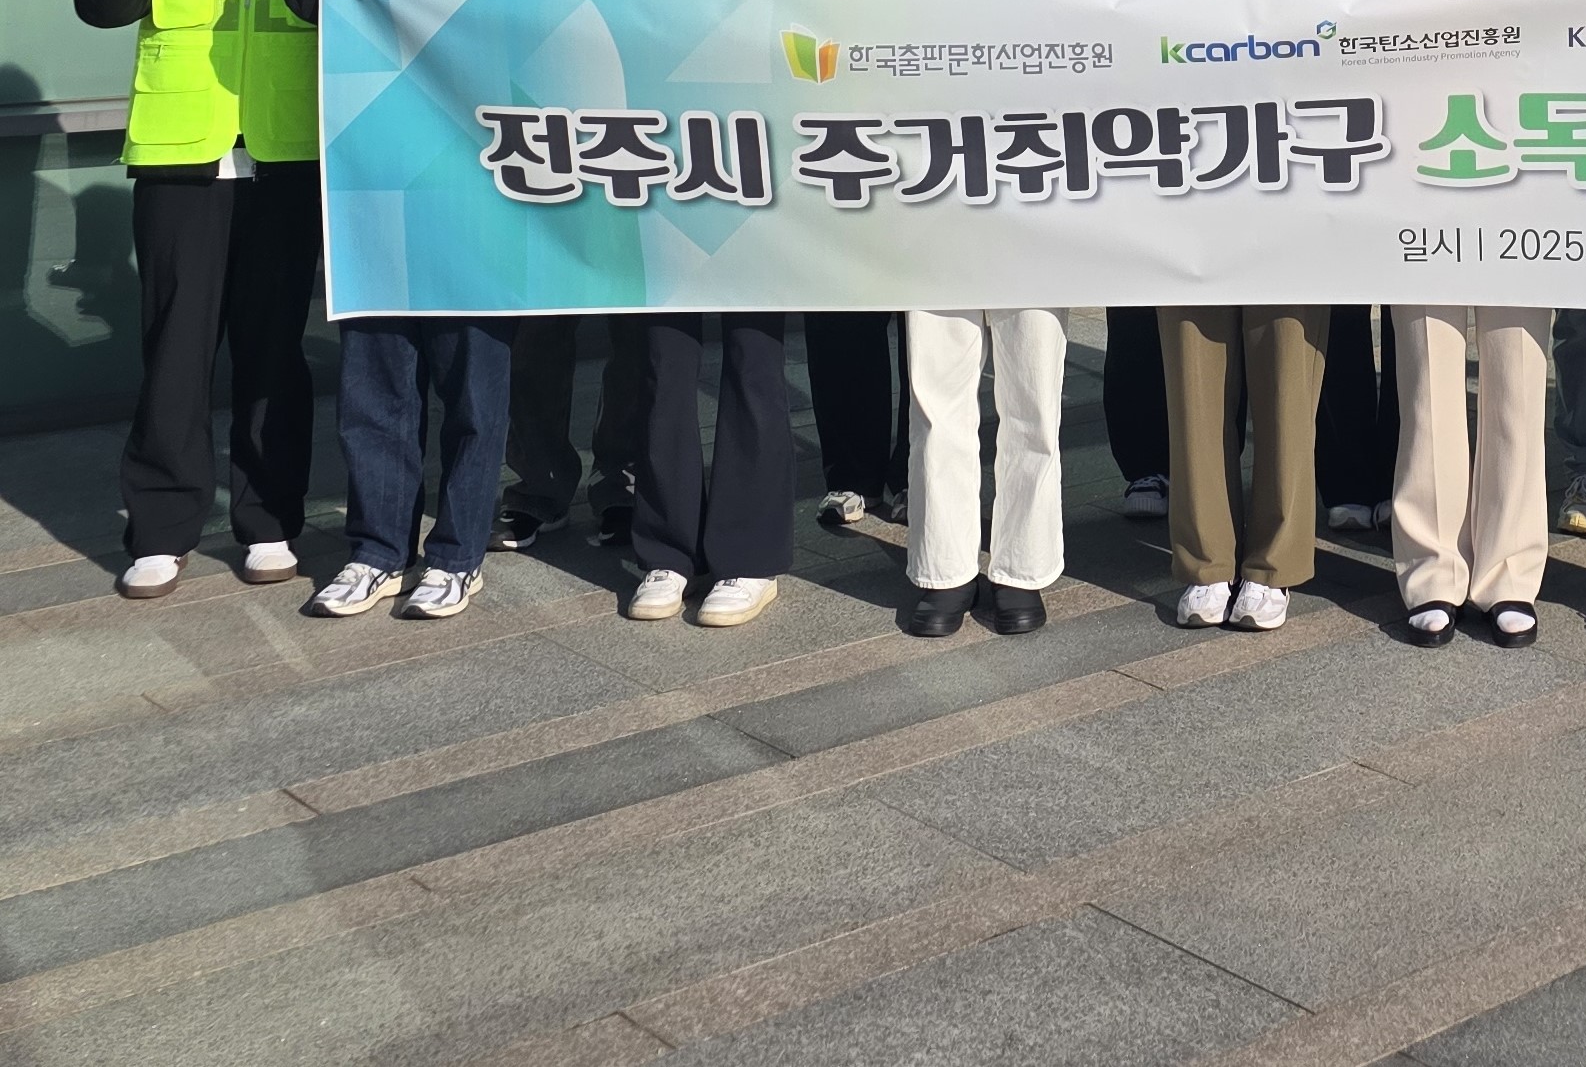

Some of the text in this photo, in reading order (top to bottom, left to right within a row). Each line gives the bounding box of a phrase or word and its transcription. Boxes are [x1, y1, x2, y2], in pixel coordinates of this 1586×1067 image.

[1161, 34, 1320, 64] kcarbon
[1338, 26, 1521, 55] 한국탄소산업진흥원
[1567, 27, 1586, 48] K
[848, 41, 1113, 77] 한국출판문화산업진흥원
[1341, 49, 1521, 67] Korea Carbon Industry Promotion Agency
[480, 107, 772, 202] 전주시
[797, 95, 1387, 204] 주거취약가구
[1398, 227, 1462, 263] 일시
